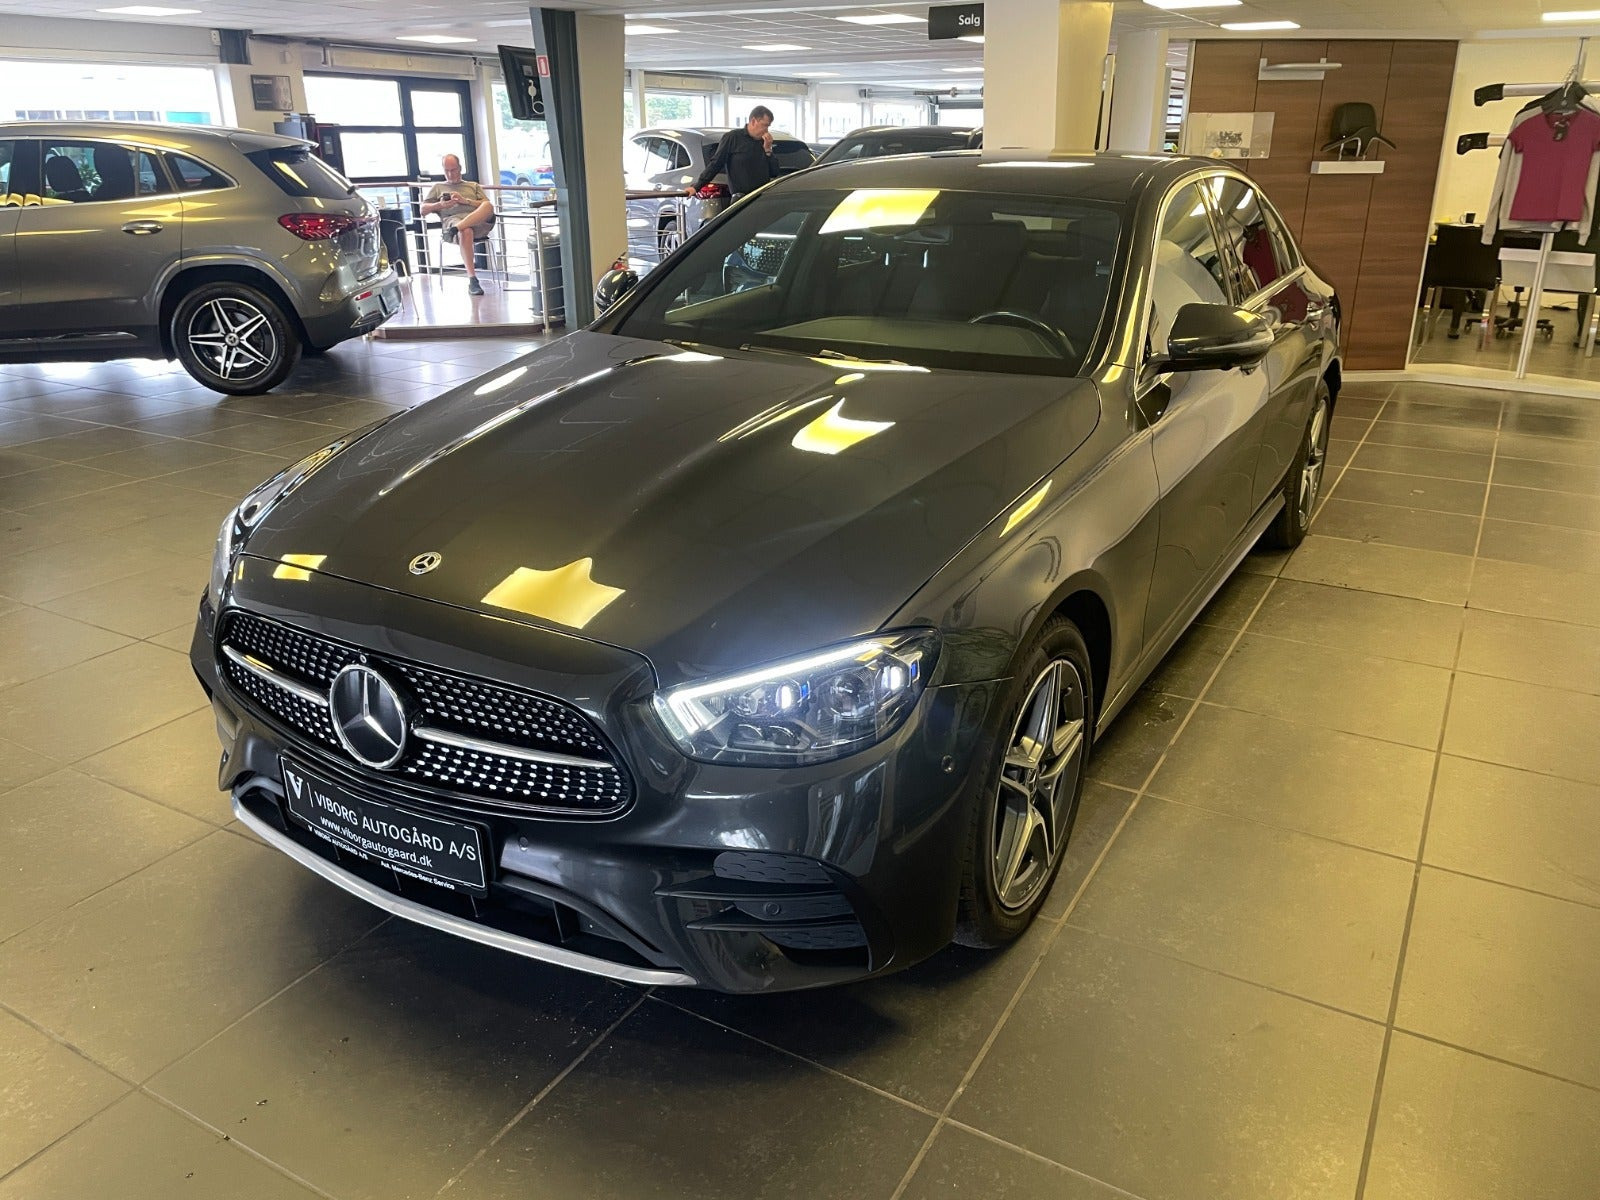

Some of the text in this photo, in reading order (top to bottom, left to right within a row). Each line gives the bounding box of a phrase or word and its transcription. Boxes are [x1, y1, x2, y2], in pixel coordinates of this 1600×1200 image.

[958, 13, 981, 27] Salg
[314, 790, 359, 826] VIBORG
[362, 815, 444, 852] AUTOGÅRD
[449, 841, 477, 861] A/S
[320, 816, 433, 868] www.viborgautogaard.dk
[433, 878, 456, 891] Service
